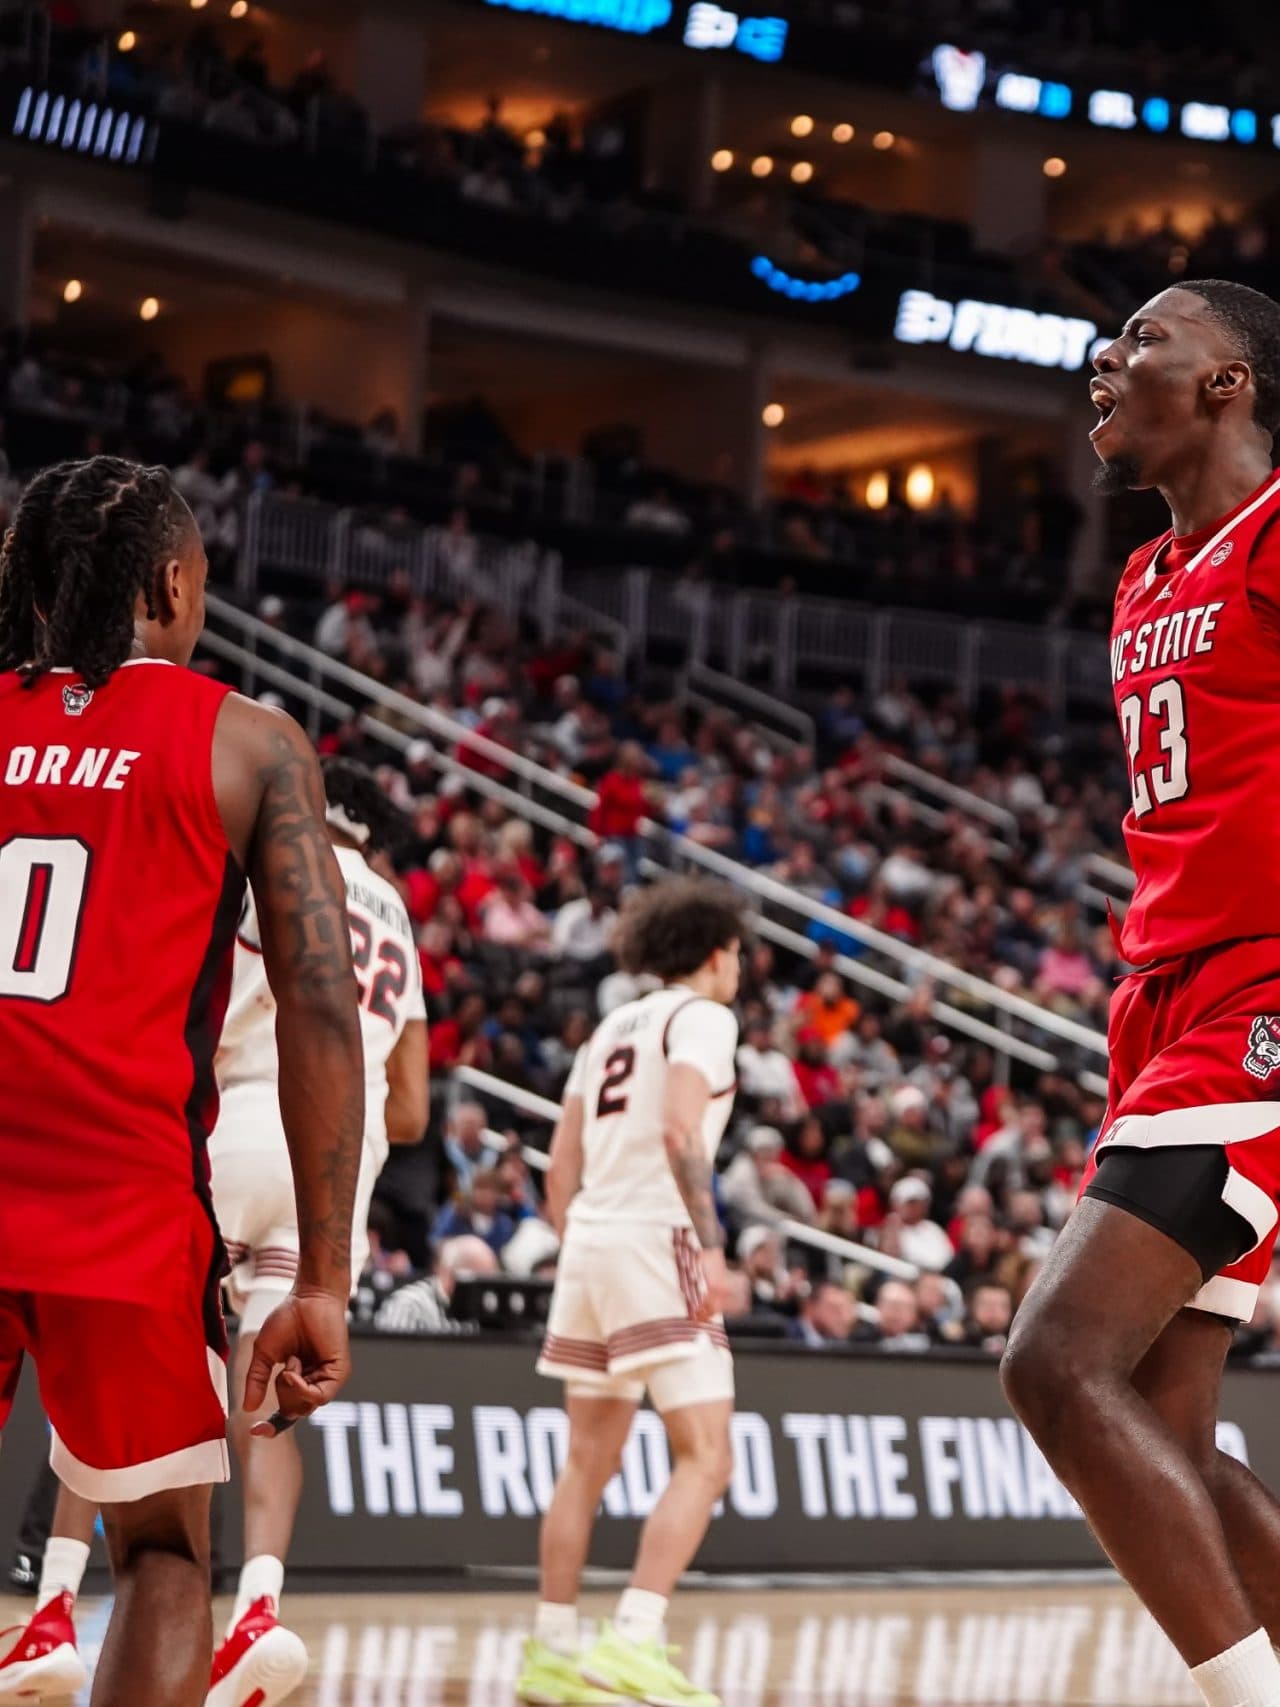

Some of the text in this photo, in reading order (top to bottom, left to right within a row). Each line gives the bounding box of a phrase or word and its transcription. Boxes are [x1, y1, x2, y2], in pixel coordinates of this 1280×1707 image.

[1130, 602, 1225, 674] STATE
[4, 744, 142, 790] ORNE
[1120, 677, 1189, 821] 23
[0, 835, 92, 1004] 0
[597, 1046, 636, 1118] 2
[309, 1400, 463, 1518] THE
[472, 1406, 672, 1518] ROD
[711, 1411, 778, 1519] O
[781, 1413, 918, 1520] THE
[917, 1415, 1087, 1520] FINA
